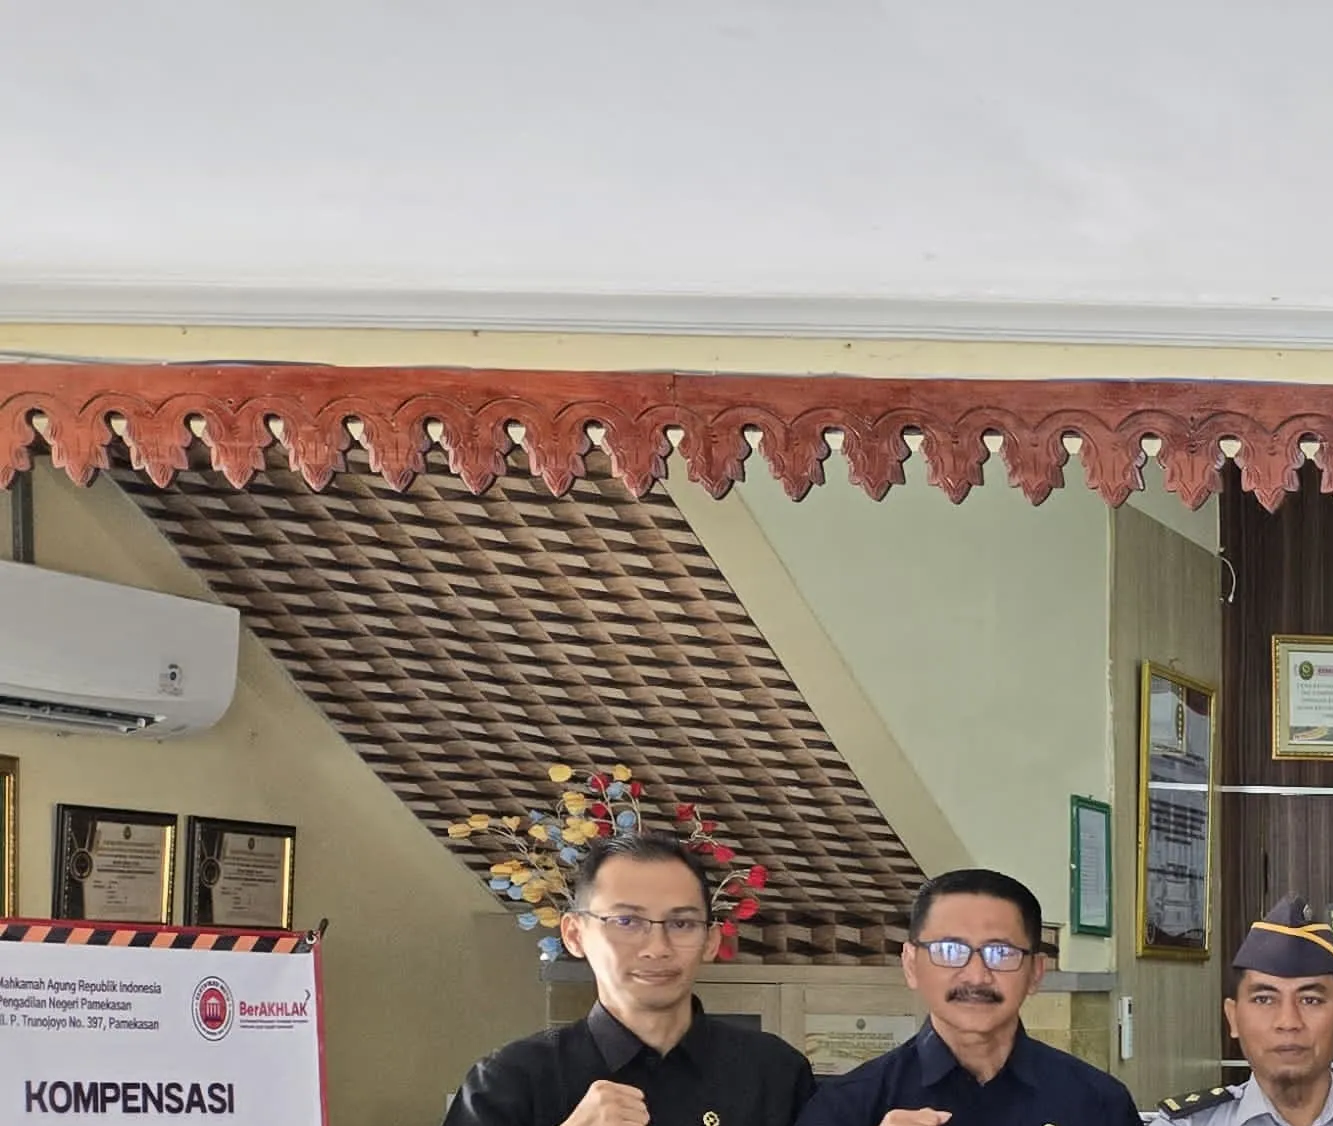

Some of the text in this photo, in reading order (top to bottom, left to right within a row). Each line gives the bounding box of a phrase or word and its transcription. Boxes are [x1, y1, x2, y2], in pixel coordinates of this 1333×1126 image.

[47, 978, 76, 994] Agung
[78, 979, 118, 995] Republik
[119, 981, 162, 995] Indonesia
[49, 997, 79, 1013] Negeri
[81, 998, 132, 1012] Pamekasan
[239, 1001, 308, 1017] BerAKHLAK
[10, 1014, 20, 1027] P.
[22, 1015, 67, 1031] Trunojoyo
[69, 1016, 85, 1028] No.
[87, 1016, 106, 1031] 397,
[109, 1017, 160, 1030] Pamekasan
[25, 1080, 235, 1115] KOMPENSASI
